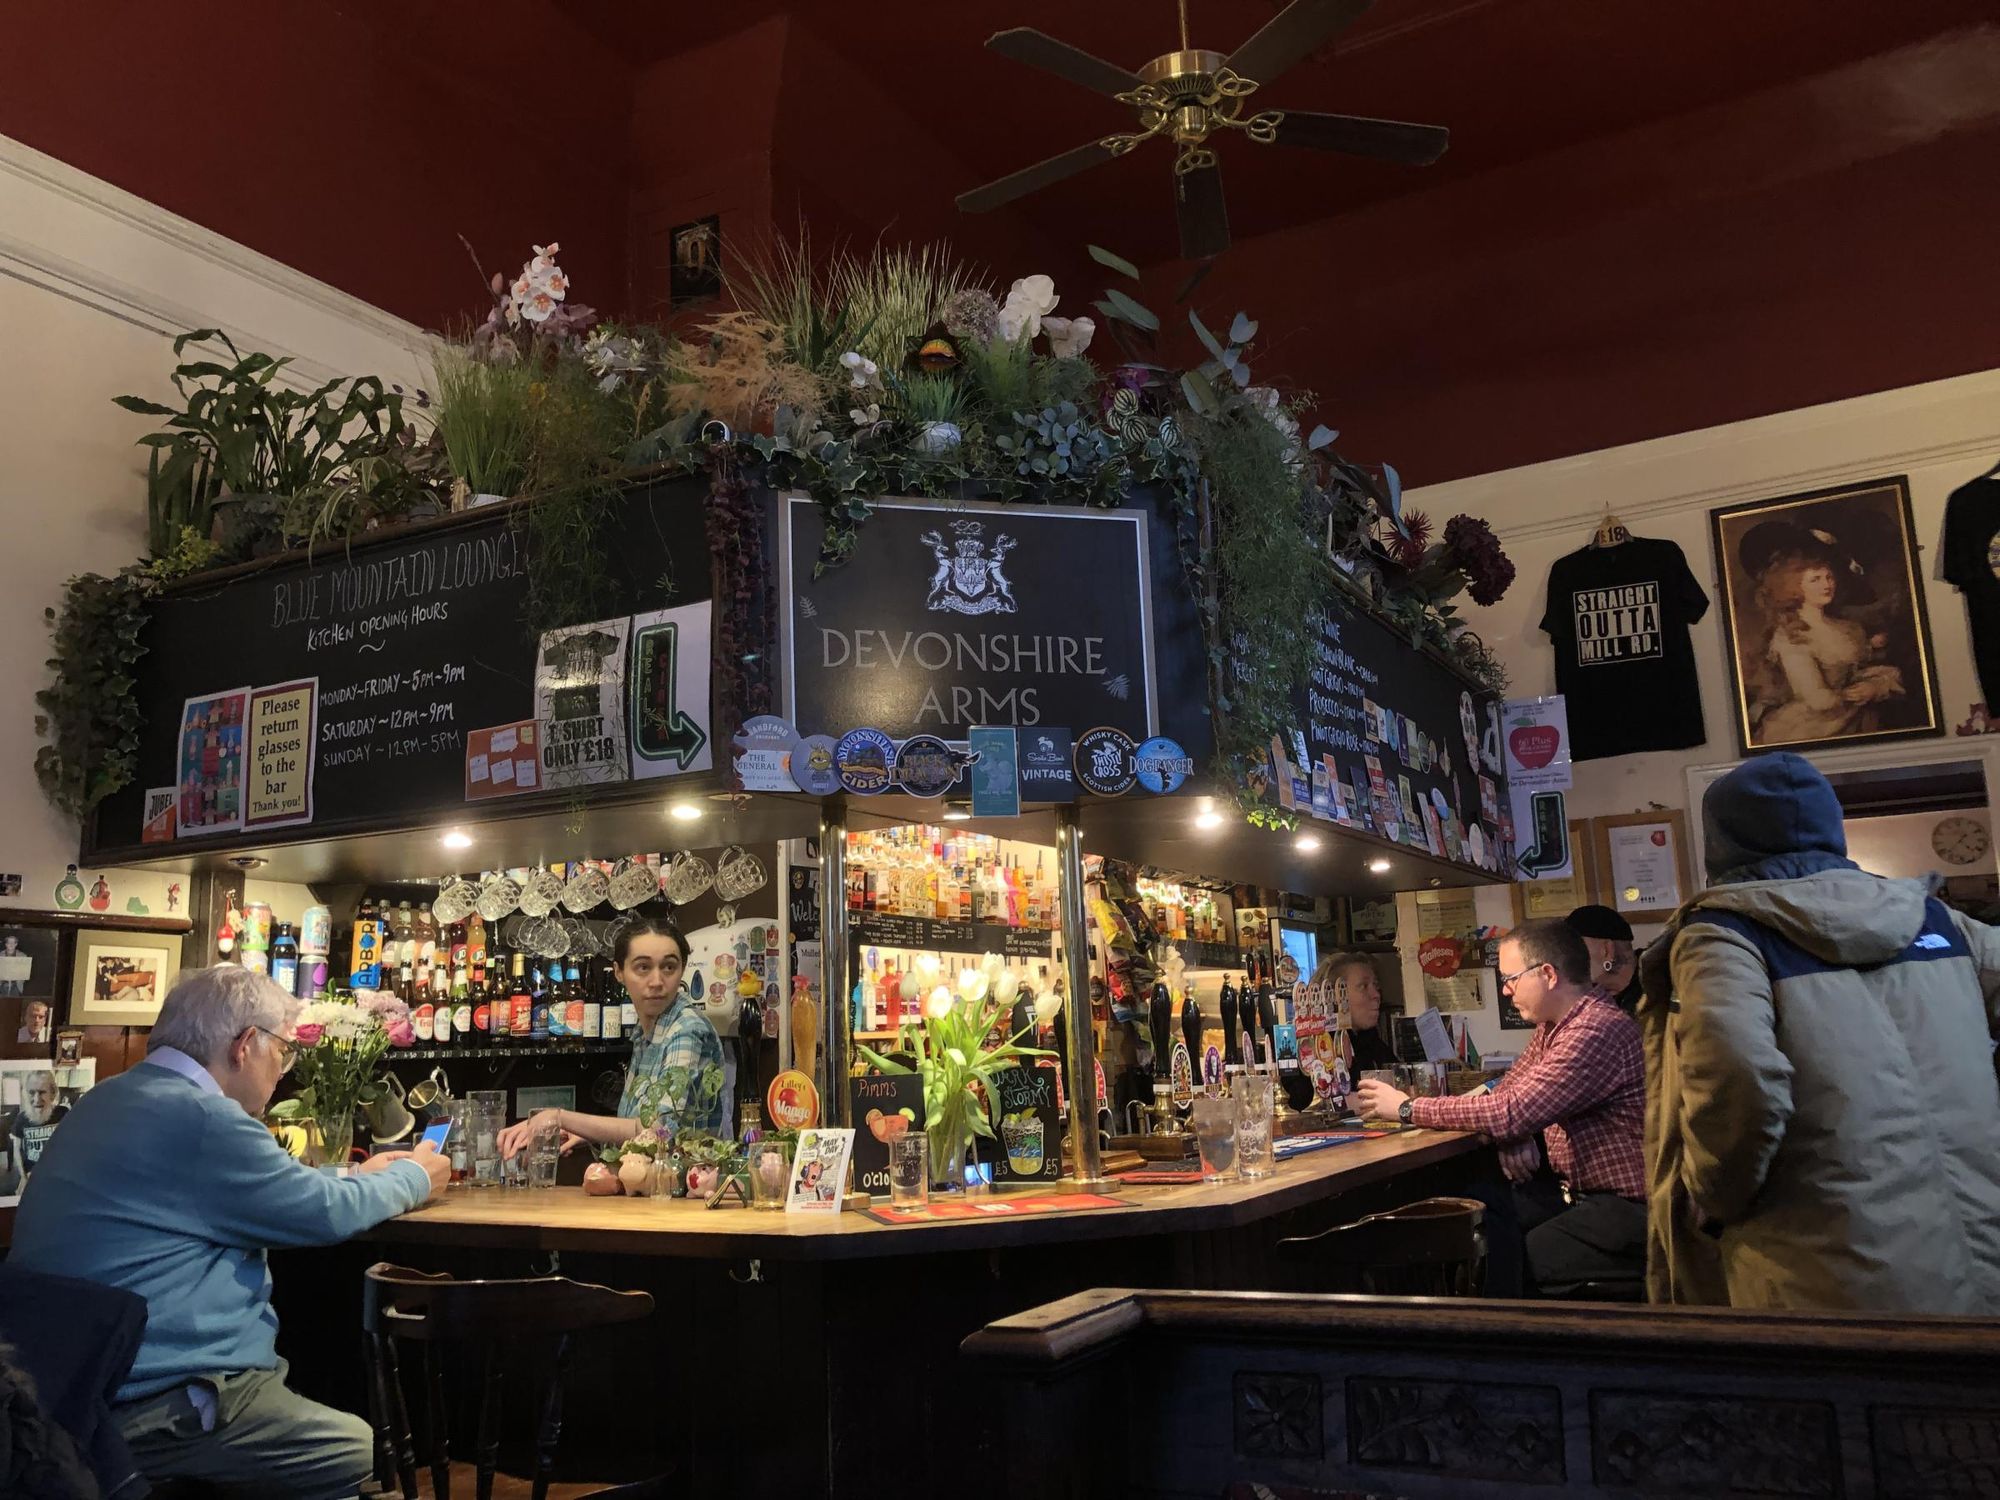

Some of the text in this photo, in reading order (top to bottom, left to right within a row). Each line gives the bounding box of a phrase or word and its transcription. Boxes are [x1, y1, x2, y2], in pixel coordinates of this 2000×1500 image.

[271, 530, 525, 629] BLUE MOUNTAIN LOUNGE
[1577, 584, 1655, 612] STRAIGHT
[307, 601, 449, 652] KITCHEN OPENING HOURS
[1579, 606, 1657, 640] OUTTA
[820, 627, 1108, 676] DEVONSHIRE
[1581, 633, 1659, 661] MILL RD.
[262, 698, 301, 716] Please
[912, 685, 1041, 727] ARMS
[261, 718, 299, 737] return
[563, 716, 605, 742] SHIRT
[257, 738, 301, 762] glasses
[837, 731, 894, 766] MOONSHINE
[1082, 731, 1132, 751] WHISKY CASK
[323, 743, 372, 767] SUNDAY
[543, 741, 580, 768] ONLY
[585, 737, 615, 763] £18
[748, 754, 766, 762] THE
[1091, 749, 1123, 767] THISTLY
[261, 758, 296, 776] to the
[737, 761, 777, 771] GENERAL
[1093, 764, 1121, 778] CROSS
[842, 772, 889, 790] CIDER
[1021, 769, 1072, 783] VINTAGE
[1082, 772, 1132, 793] SCOTTISH CIDER
[265, 779, 287, 796] bar
[252, 795, 301, 813] Thank you!
[791, 900, 818, 922] Welc
[774, 1100, 811, 1122] Mango
[25, 1125, 56, 1139] STRAIG
[822, 1138, 839, 1148] MAY
[825, 1146, 839, 1155] DAY
[994, 1160, 1008, 1176] £5
[1044, 1158, 1058, 1176] £5
[863, 1171, 890, 1189] O'clo
